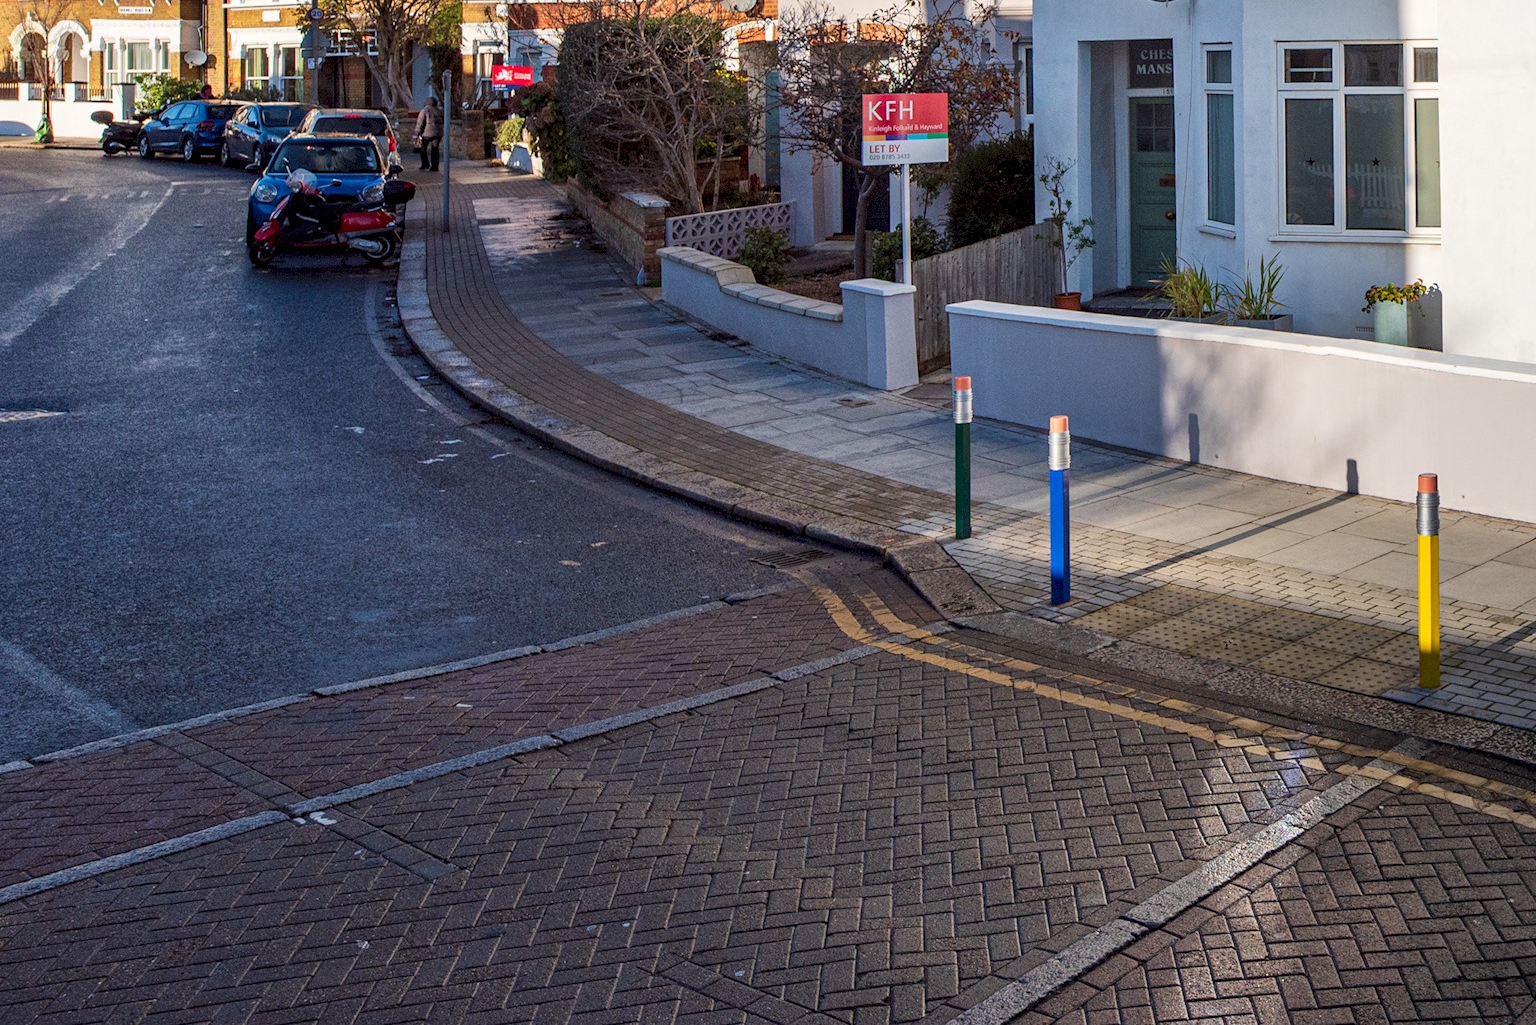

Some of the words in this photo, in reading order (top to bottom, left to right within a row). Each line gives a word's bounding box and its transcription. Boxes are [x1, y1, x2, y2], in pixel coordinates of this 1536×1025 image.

[1136, 63, 1172, 75] MANS
[868, 100, 914, 122] KFH
[868, 125, 892, 133] Kinleigh
[893, 123, 913, 131] Folkard
[920, 123, 943, 131] Hayward
[869, 144, 886, 154] LET
[888, 144, 901, 153] BY
